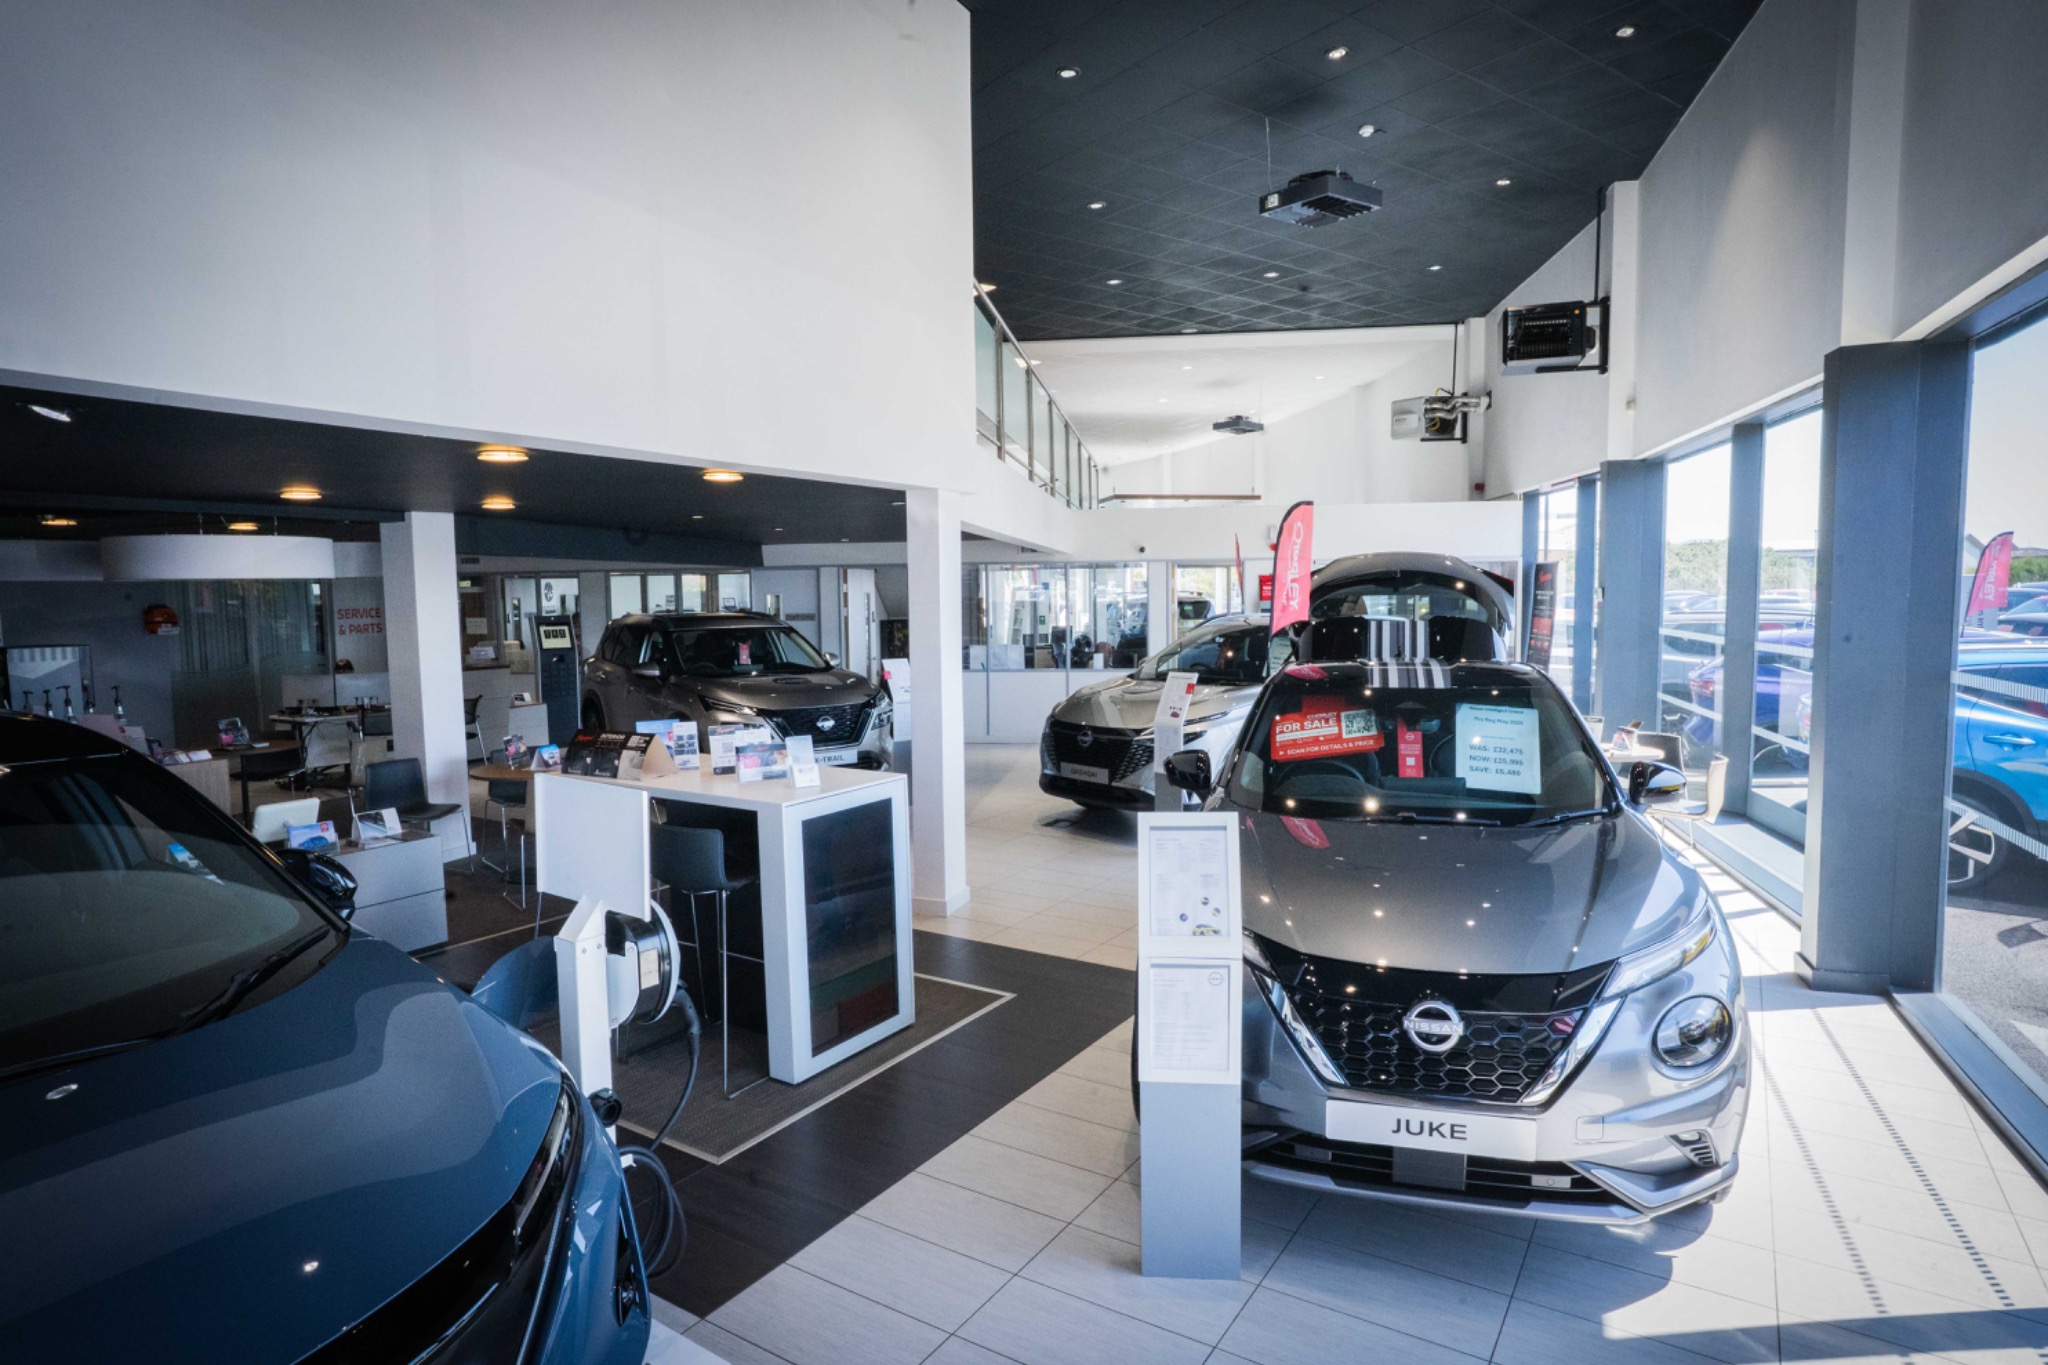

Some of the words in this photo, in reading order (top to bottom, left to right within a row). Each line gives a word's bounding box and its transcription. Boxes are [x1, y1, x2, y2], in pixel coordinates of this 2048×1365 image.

[337, 607, 382, 620] SERVICE
[338, 624, 346, 636] &
[348, 622, 383, 635] PARTS
[1275, 721, 1301, 734] FOR
[1303, 717, 1338, 730] SALE
[1287, 748, 1305, 756] SCAN
[1306, 745, 1320, 753] FOR
[1320, 742, 1348, 751] DETAILS
[1354, 739, 1375, 747] PRICE
[1469, 743, 1490, 752] WAS:
[814, 754, 845, 763] X-TRAIL
[1469, 754, 1492, 763] NOW:
[1469, 765, 1492, 774] SAVE:
[1403, 1019, 1463, 1035] NISSAN
[1391, 1117, 1468, 1141] JUKE
